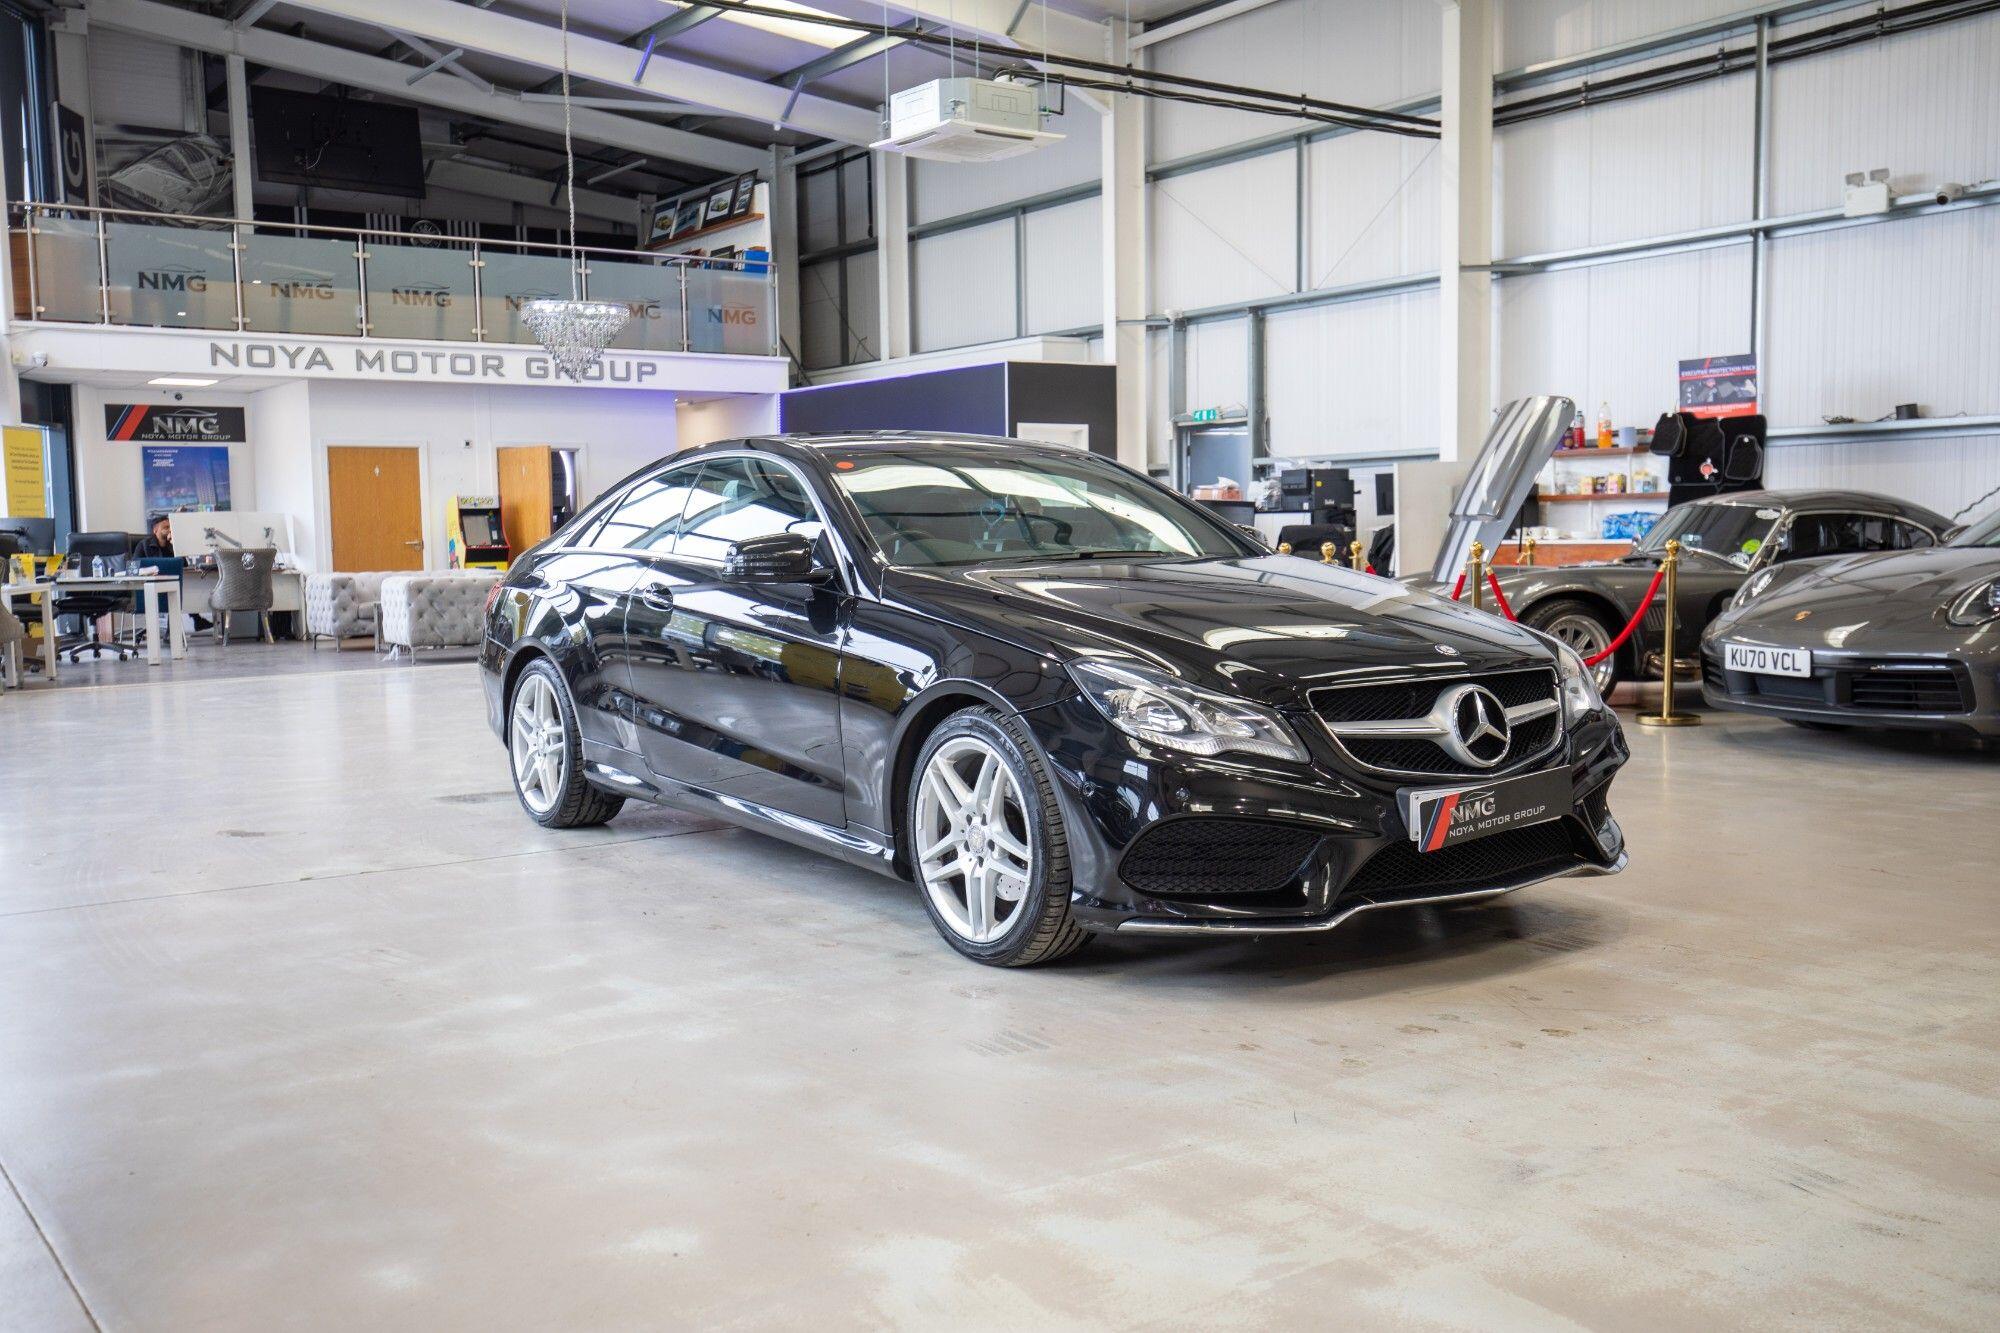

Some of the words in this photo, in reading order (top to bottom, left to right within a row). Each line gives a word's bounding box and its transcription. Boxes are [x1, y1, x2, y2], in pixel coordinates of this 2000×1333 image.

[138, 271, 207, 292] NMG
[270, 282, 334, 300] NMG
[392, 288, 451, 307] NMG
[628, 303, 661, 319] MG
[708, 308, 756, 325] NMG
[210, 342, 334, 371] NOYA
[355, 349, 505, 377] MOTOR
[152, 416, 219, 434] NMG
[1731, 648, 1766, 669] KU70
[1771, 651, 1801, 672] VCL
[1449, 797, 1496, 826] NMG
[1449, 824, 1475, 838] NOYA
[1477, 814, 1511, 830] MOTOR
[1514, 805, 1546, 821] GROUP
